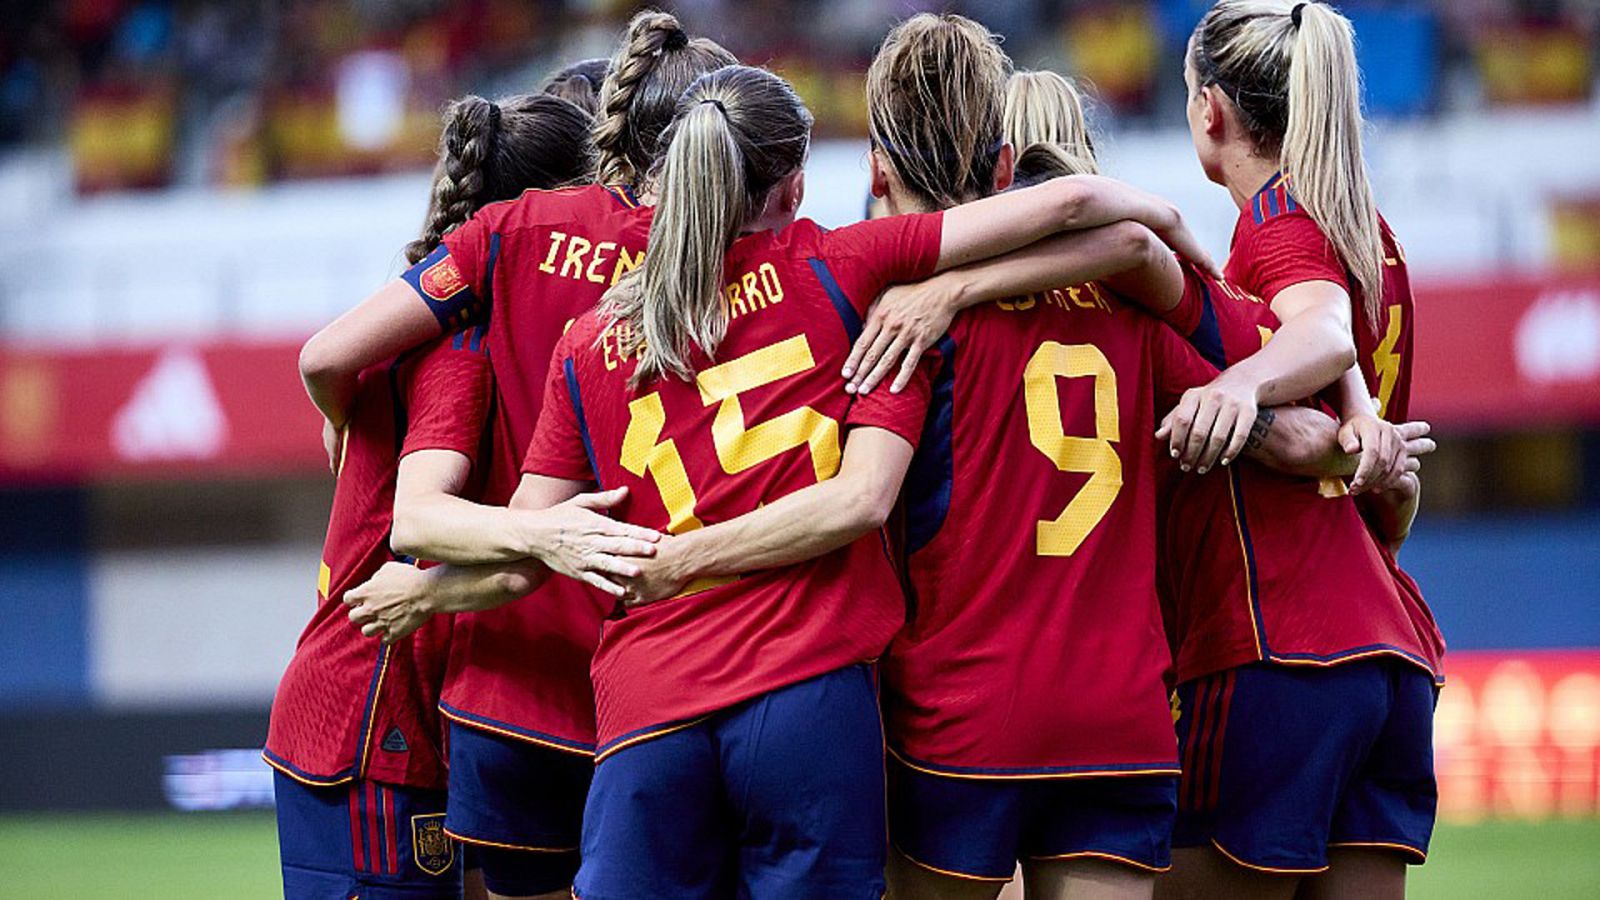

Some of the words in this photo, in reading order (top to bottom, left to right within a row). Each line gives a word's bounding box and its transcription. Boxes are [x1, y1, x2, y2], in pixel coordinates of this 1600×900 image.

[720, 262, 784, 319] RRO
[619, 333, 841, 600] 15
[1023, 340, 1124, 557] 9
